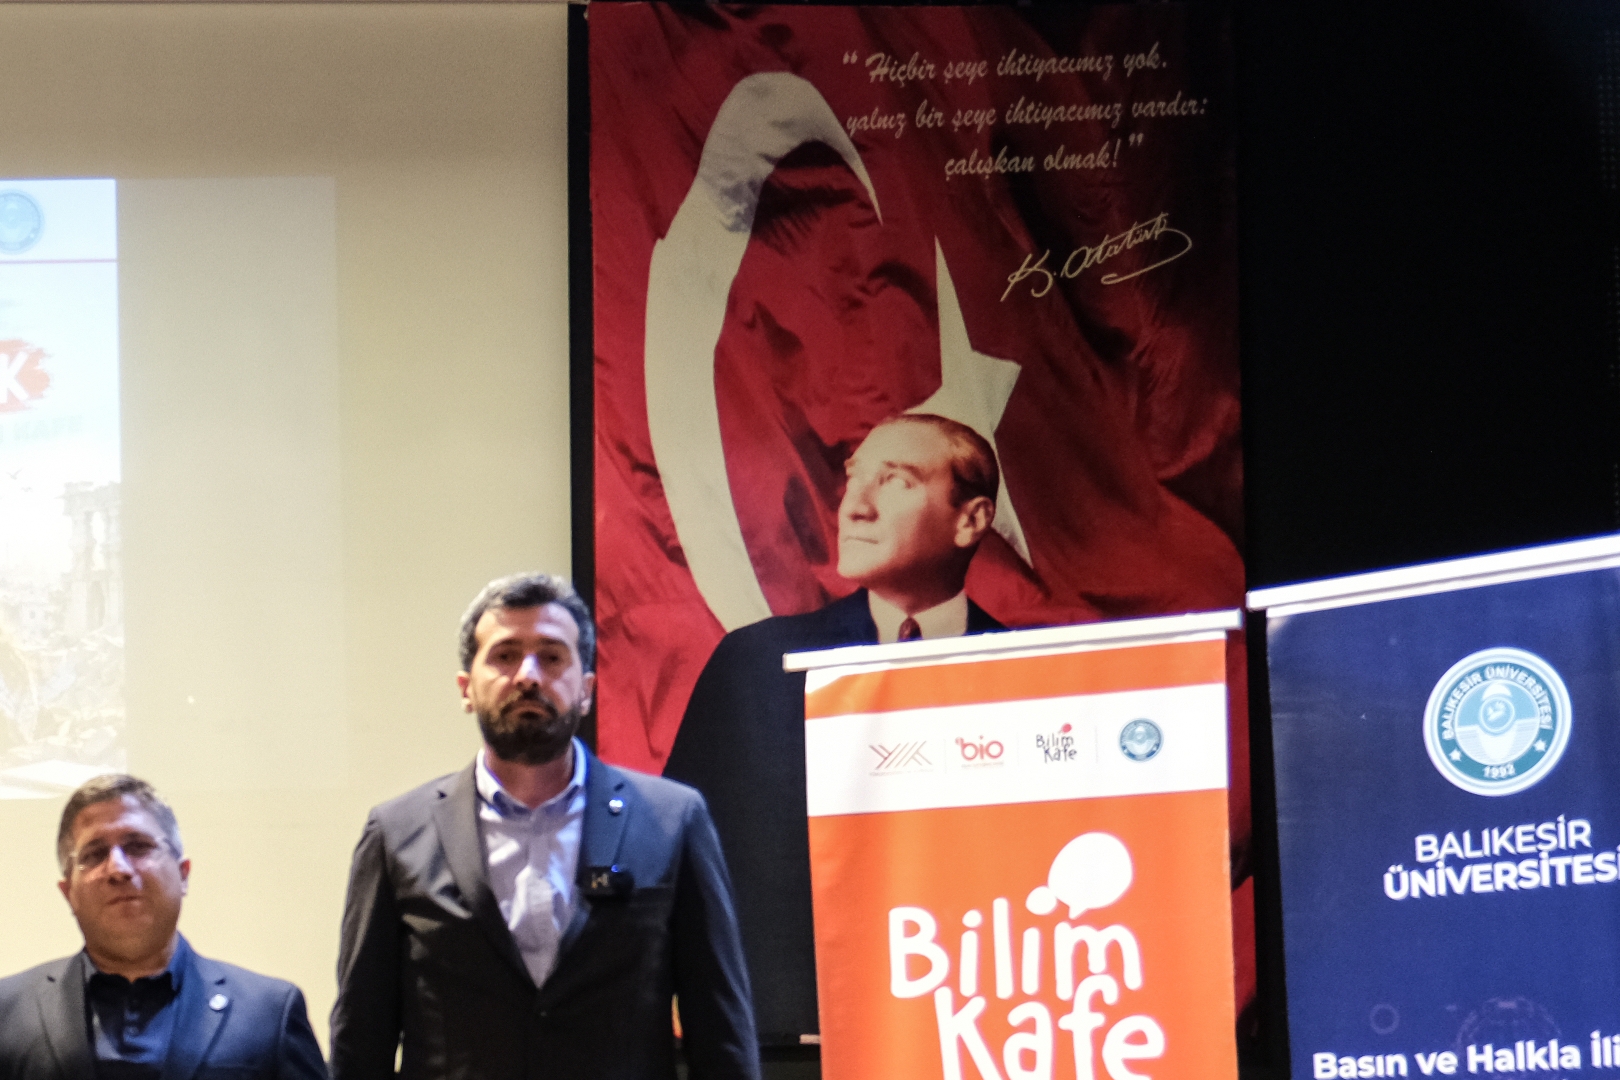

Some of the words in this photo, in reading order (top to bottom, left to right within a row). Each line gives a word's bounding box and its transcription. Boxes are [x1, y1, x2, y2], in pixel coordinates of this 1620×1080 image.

[943, 60, 988, 85] şeye
[997, 48, 1113, 82] ihtiyacımız
[1124, 41, 1167, 77] yok.
[846, 107, 906, 139] yalnız
[915, 99, 944, 128] bir
[952, 108, 997, 134] şeye
[1005, 95, 1122, 130] ihtiyacımız
[944, 146, 1035, 181] çalışkan
[1036, 732, 1074, 748] Bilim
[1044, 744, 1077, 764] Kafe
[1415, 814, 1592, 863] BALIKESİR
[888, 886, 1143, 1000] Bilim
[1312, 1052, 1409, 1080] Basın
[1414, 1051, 1458, 1076] ve
[1466, 1038, 1581, 1074] Halkla
